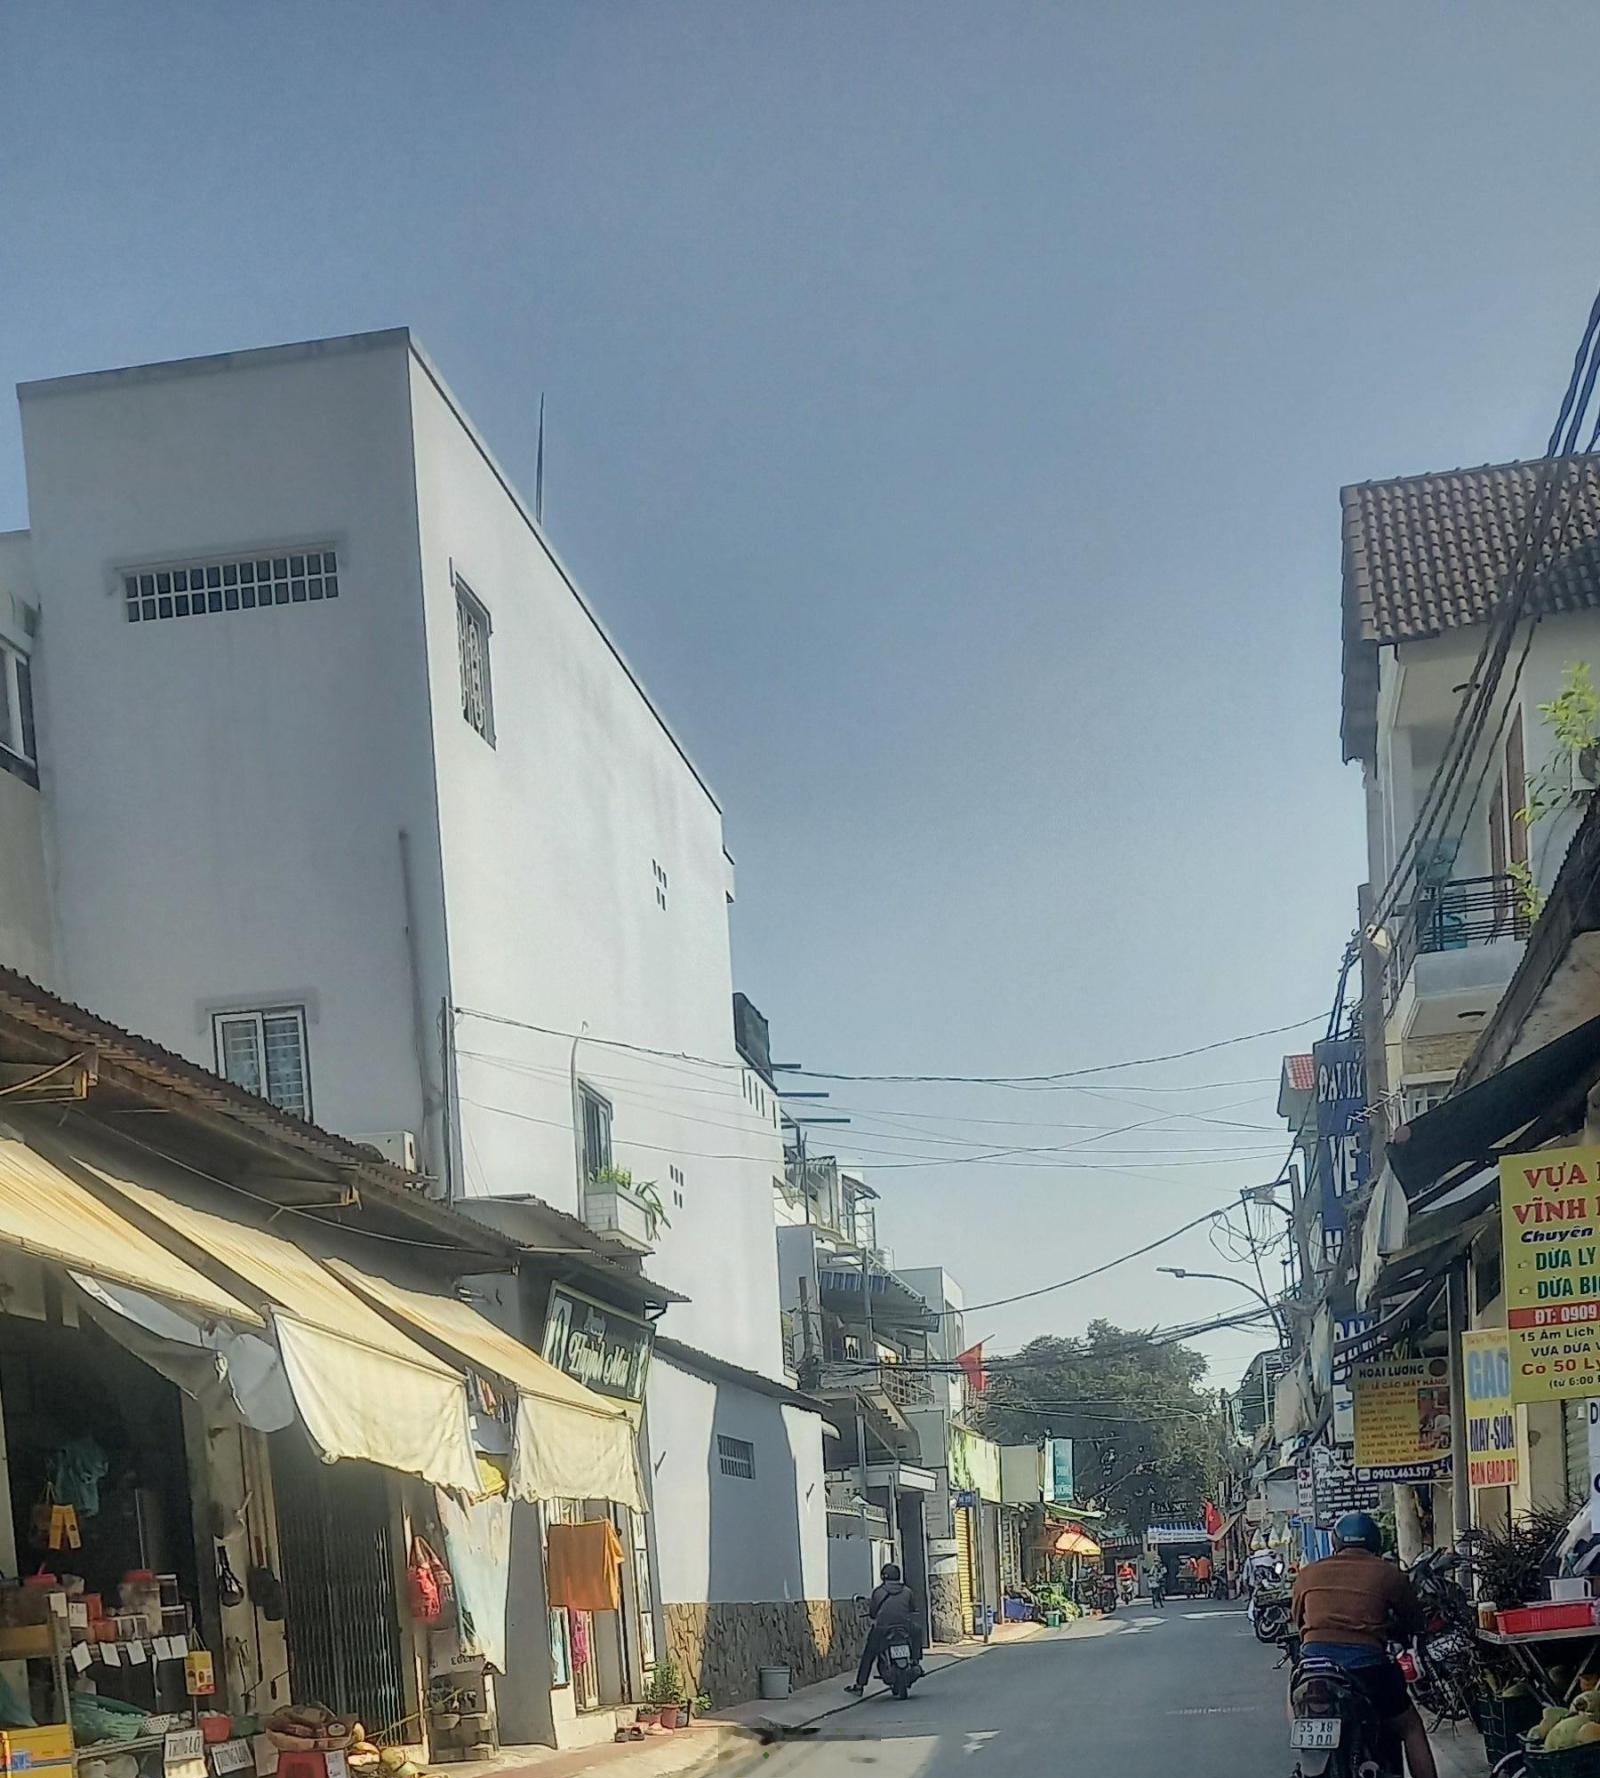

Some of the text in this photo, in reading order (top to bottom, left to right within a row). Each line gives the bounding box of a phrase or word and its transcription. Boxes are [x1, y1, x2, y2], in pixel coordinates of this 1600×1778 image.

[1523, 1162, 1588, 1192] VỰA
[1512, 1196, 1587, 1225] VĨNH
[1521, 1226, 1593, 1243] Chuyên
[1578, 1246, 1596, 1266] LY
[1580, 1275, 1600, 1298] BỊ
[1561, 1304, 1597, 1322] 0909
[1520, 1333, 1535, 1342] 15
[1554, 1359, 1576, 1373] 50
[1569, 1376, 1594, 1386] 6:00
